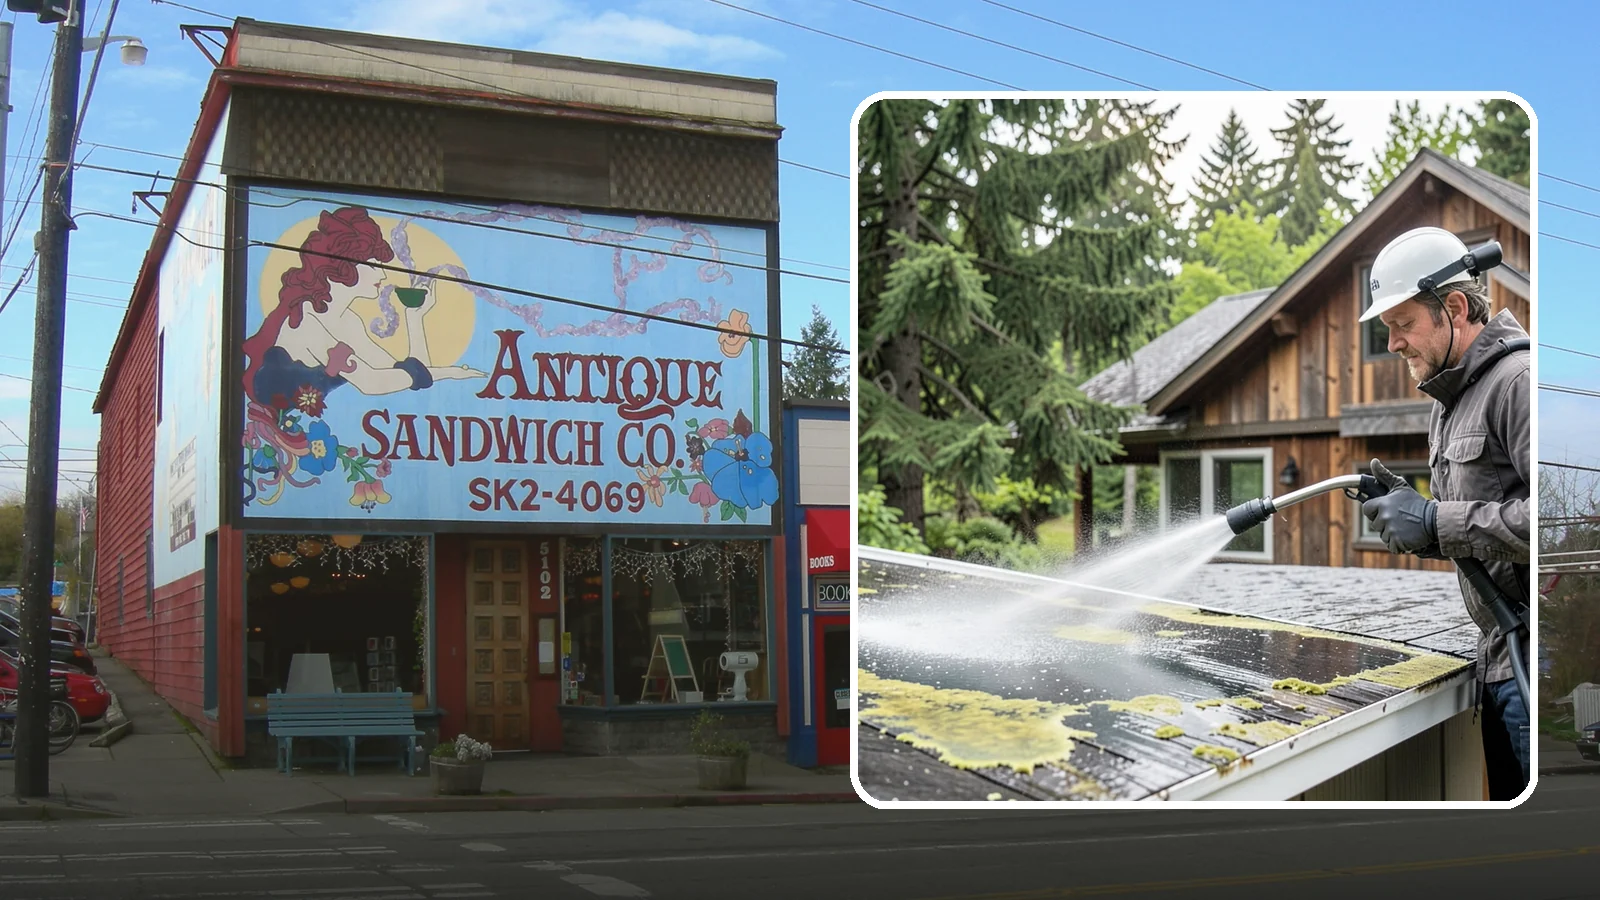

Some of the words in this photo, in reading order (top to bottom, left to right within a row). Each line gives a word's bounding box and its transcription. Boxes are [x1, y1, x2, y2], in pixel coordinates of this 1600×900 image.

[476, 329, 723, 420] ANTIQUE
[361, 407, 605, 467] SANDWICH
[616, 421, 685, 469] CO.
[469, 477, 645, 512] SK2-4069
[540, 541, 552, 600] 5102
[809, 555, 835, 569] BOOKS
